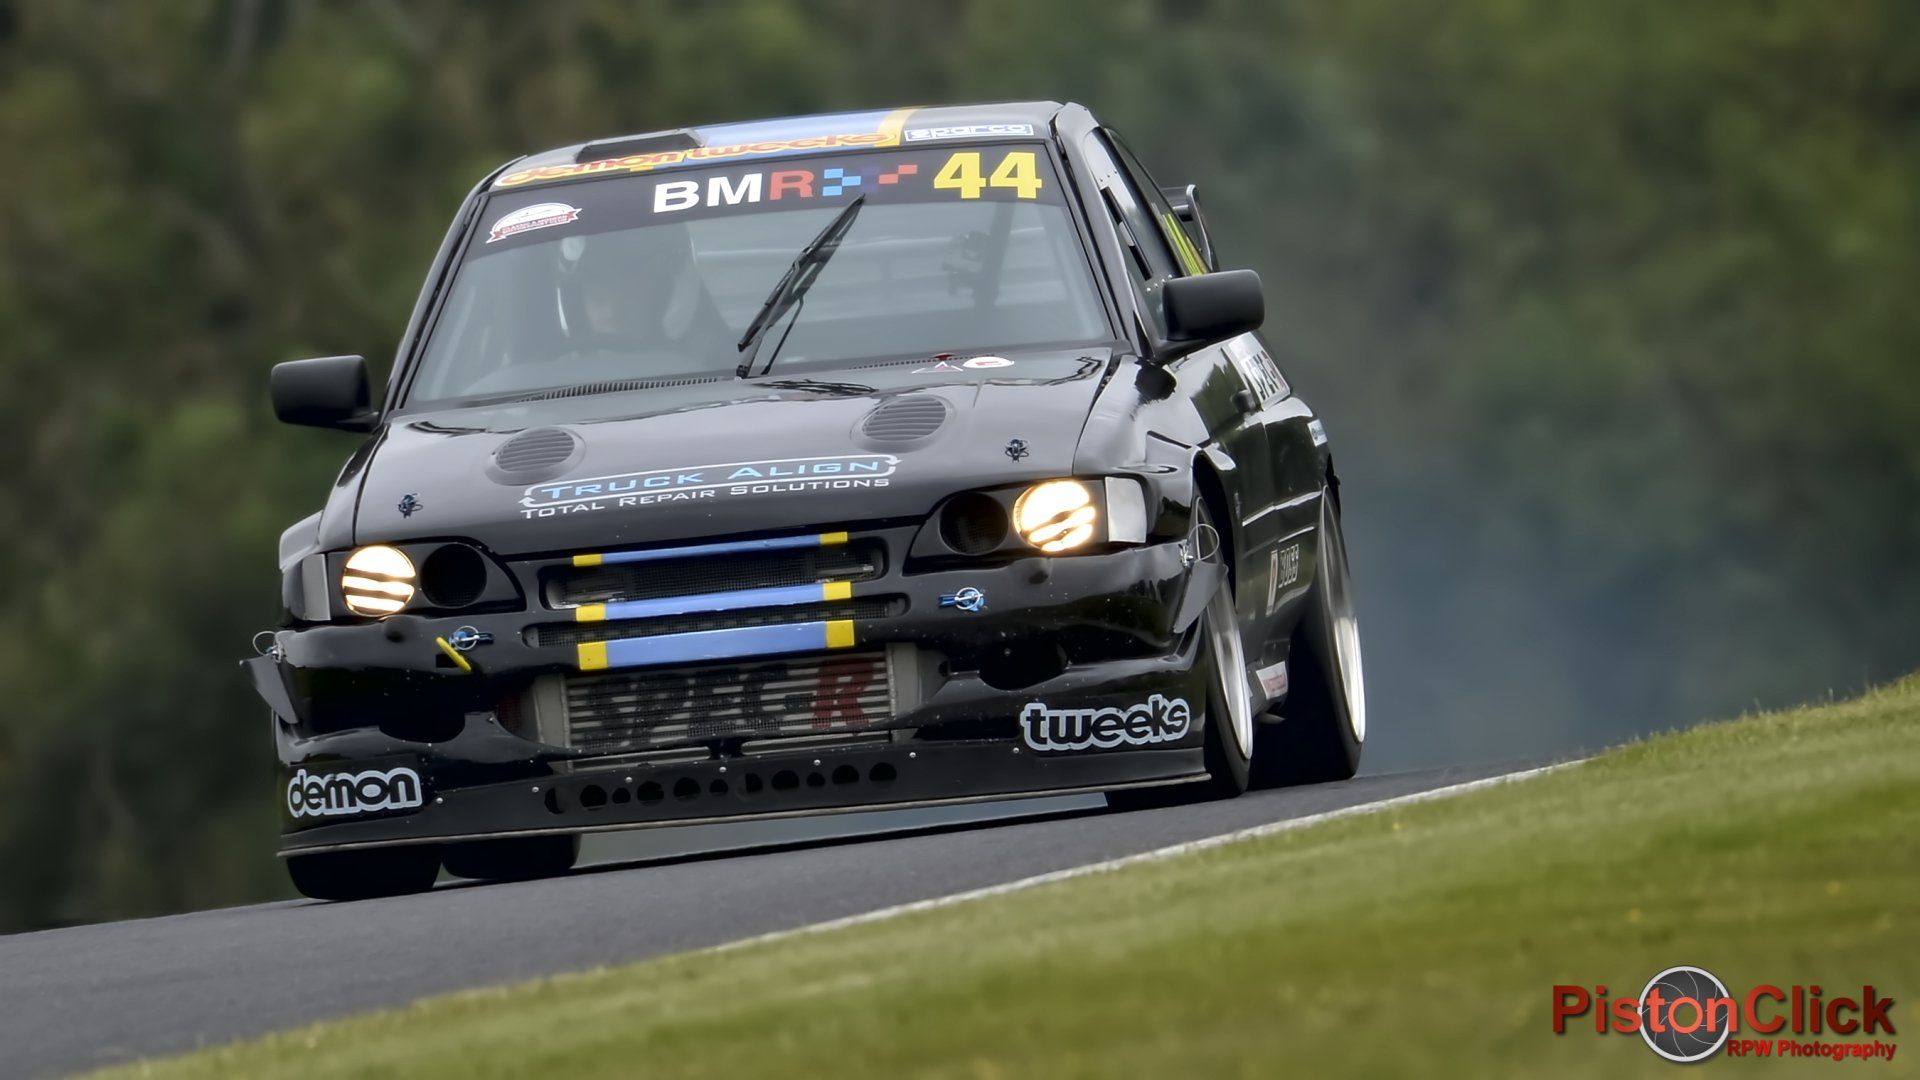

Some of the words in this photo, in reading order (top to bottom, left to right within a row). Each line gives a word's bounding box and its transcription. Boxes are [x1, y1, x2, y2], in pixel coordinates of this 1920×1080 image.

[653, 170, 815, 213] BMR
[932, 152, 1042, 199] 44
[520, 502, 605, 519] TOTAL
[619, 489, 715, 507] REPAIR
[730, 478, 890, 495] SOLUTIONS
[541, 472, 705, 499] TRUCK
[727, 461, 879, 480] ALIGN
[1020, 694, 1190, 751] tweeks
[287, 766, 422, 817] demon
